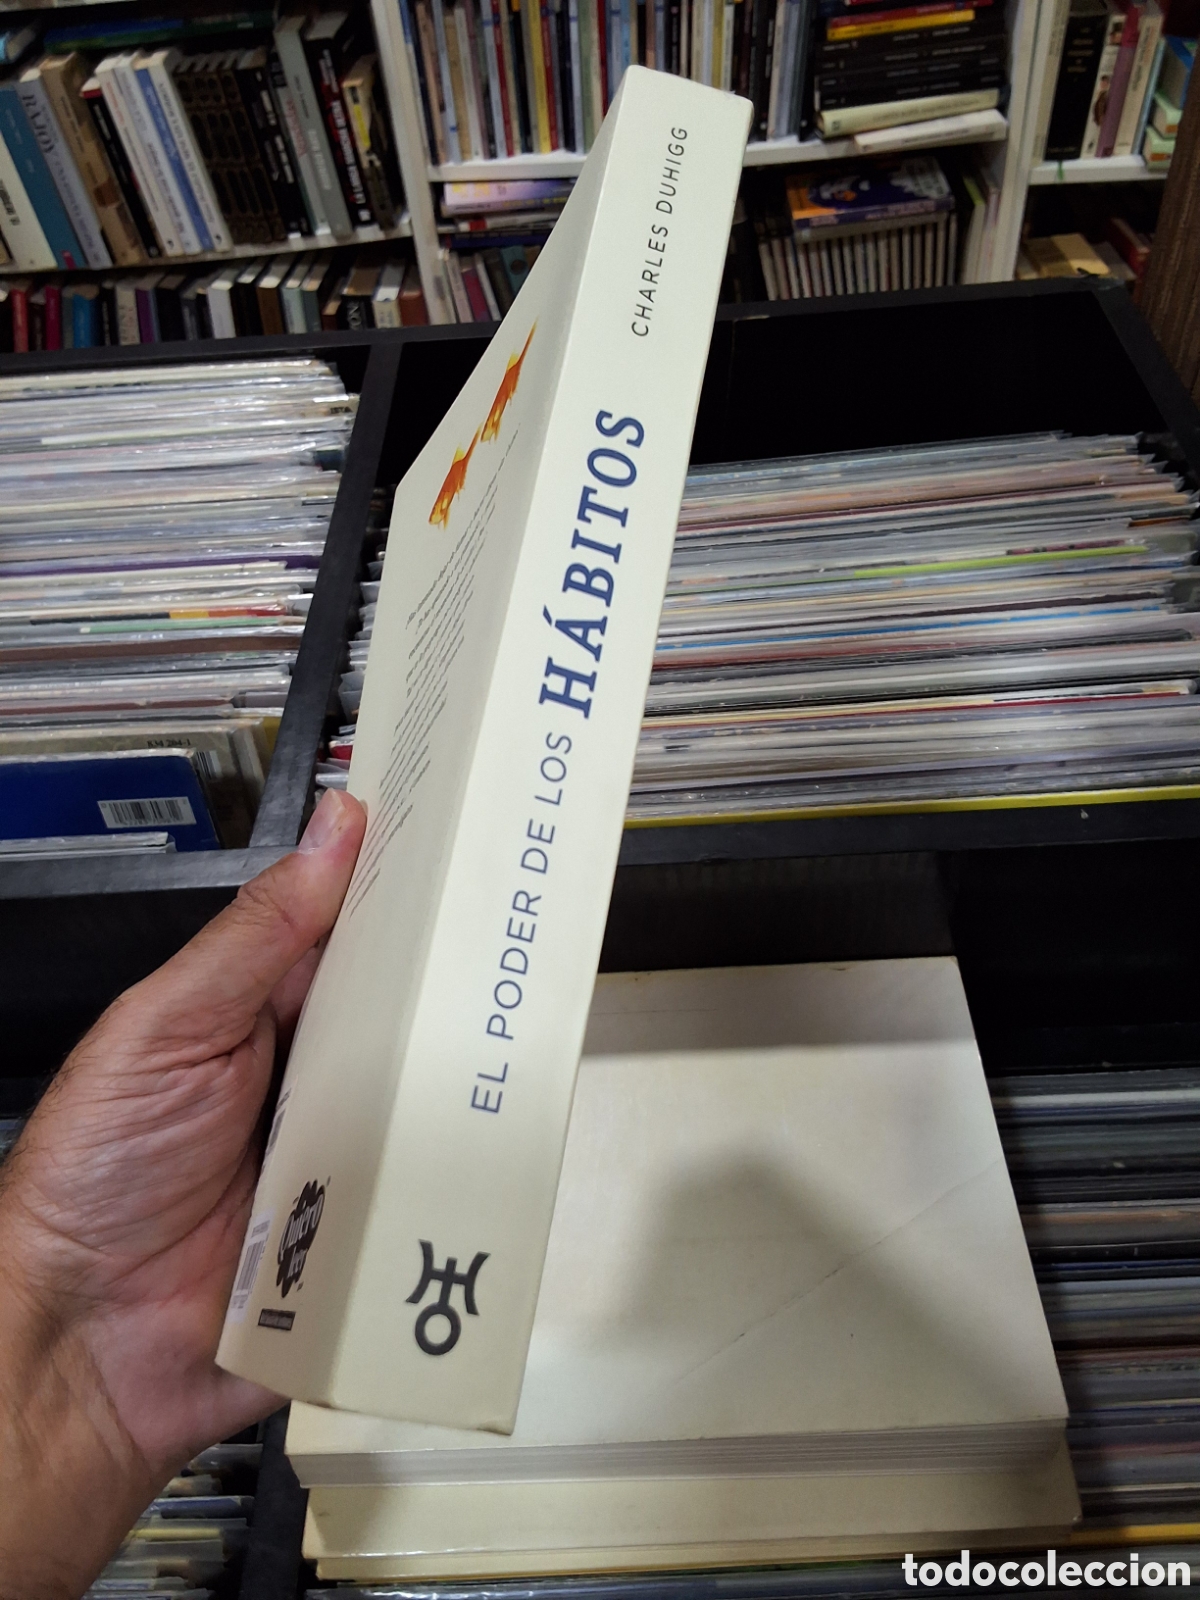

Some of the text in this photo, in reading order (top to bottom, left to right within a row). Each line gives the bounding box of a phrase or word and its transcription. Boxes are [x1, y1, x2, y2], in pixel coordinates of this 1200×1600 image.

[630, 127, 688, 337] CHARLES DUHIGG
[470, 409, 646, 1114] EL PODER DE LOS HÁBITOS
[279, 1193, 325, 1262] Quiero
